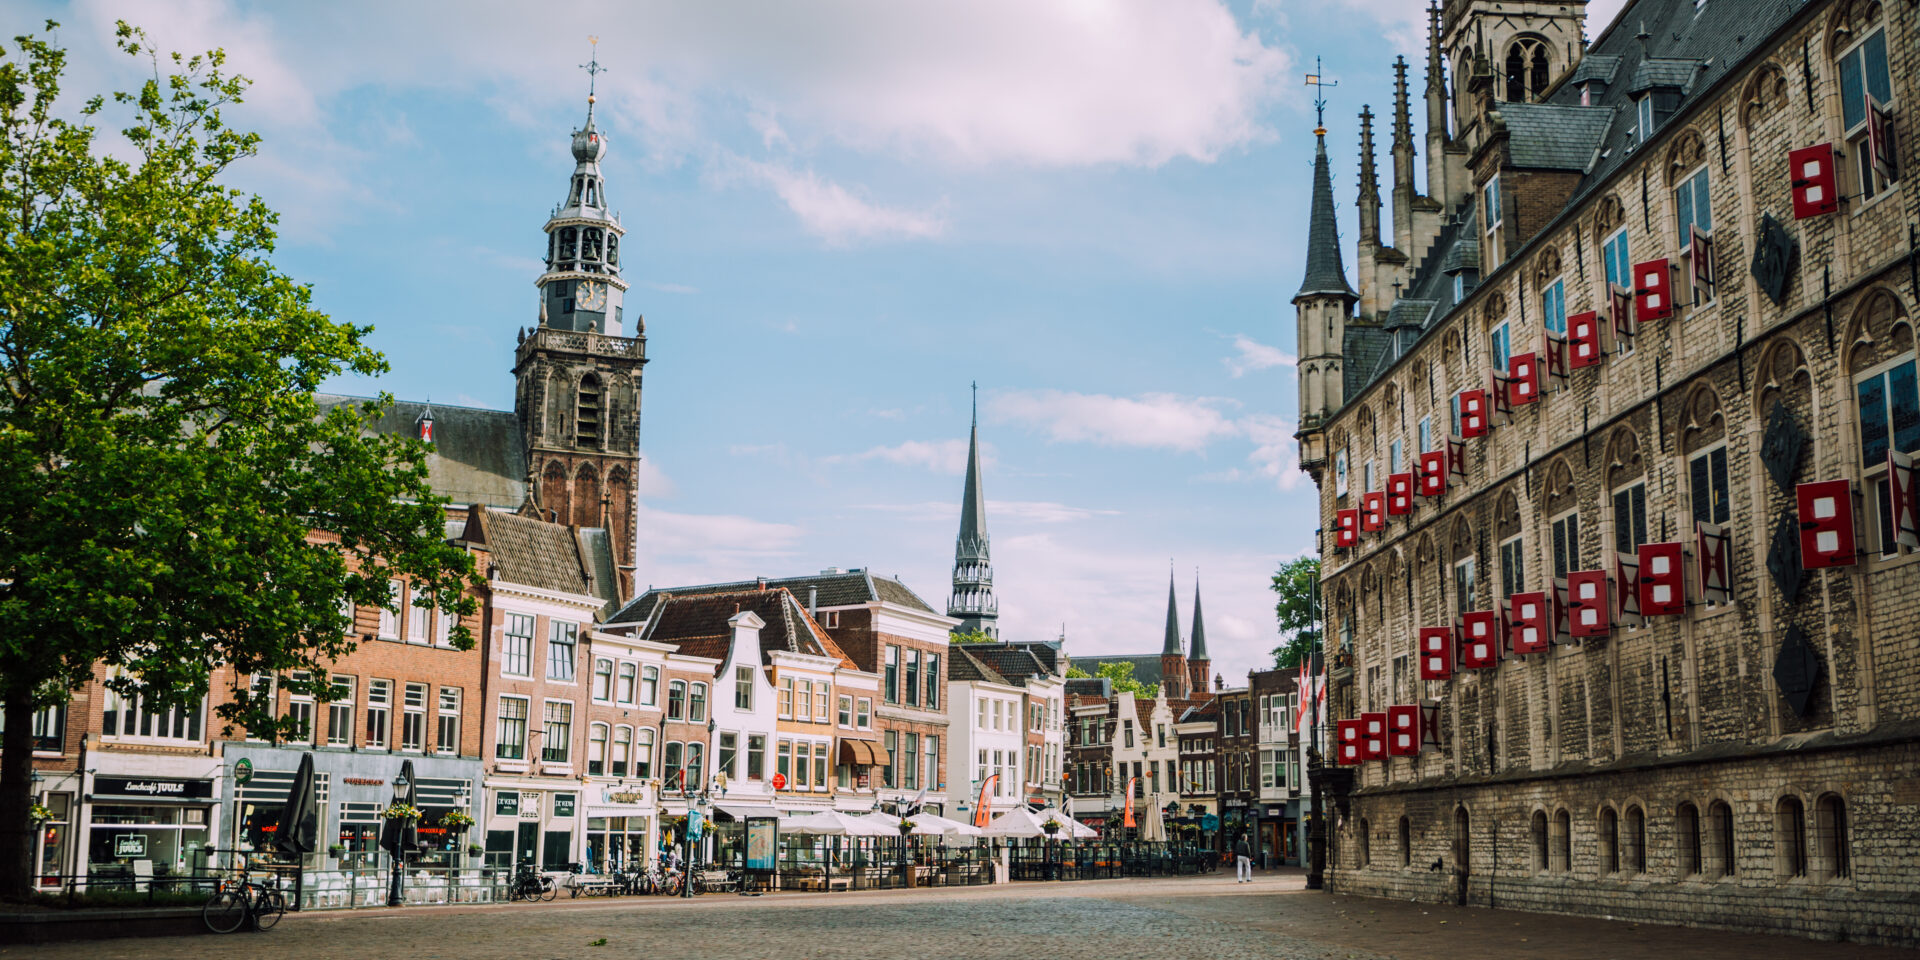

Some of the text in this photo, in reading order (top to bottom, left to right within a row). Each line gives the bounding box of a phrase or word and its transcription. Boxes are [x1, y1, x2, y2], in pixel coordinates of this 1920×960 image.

[125, 782, 183, 794] Lunchcafé JUULS
[119, 846, 143, 855] JUULS
